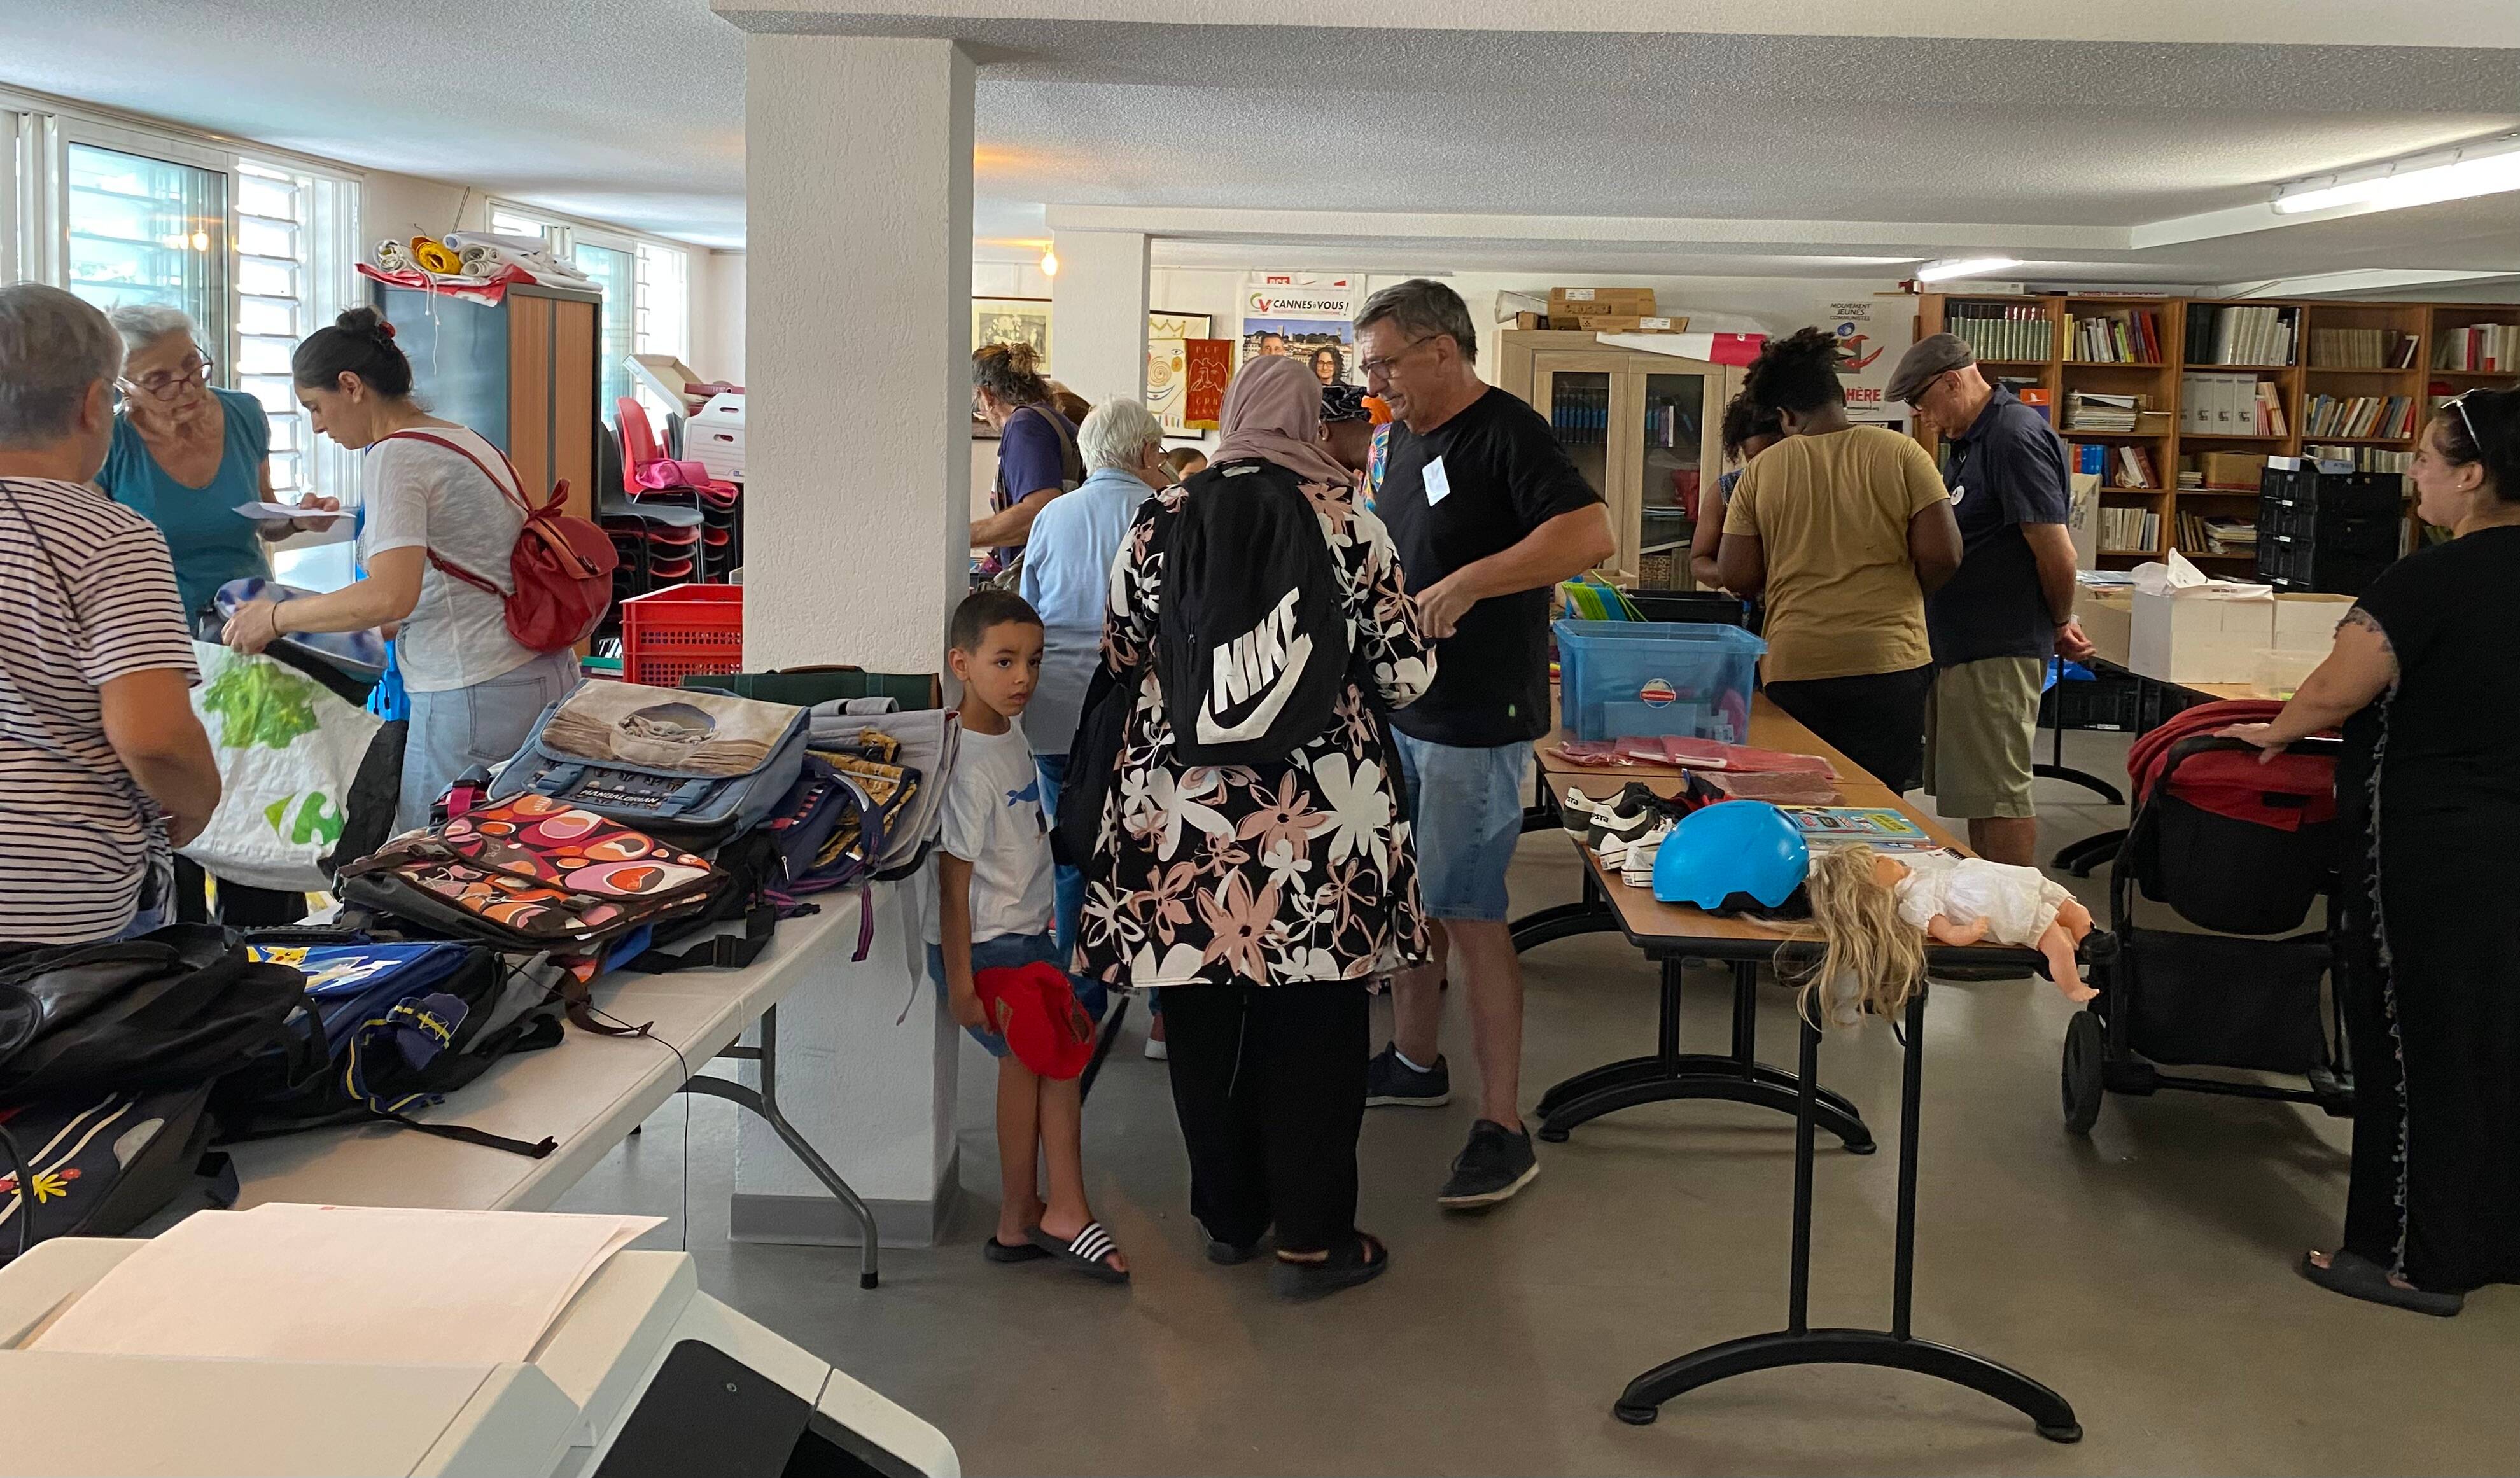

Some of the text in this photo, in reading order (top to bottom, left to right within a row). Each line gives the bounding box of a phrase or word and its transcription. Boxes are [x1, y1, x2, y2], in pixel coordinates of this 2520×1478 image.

[1273, 300, 1312, 309] CANNES
[1846, 386, 1881, 401] HÈRE
[1213, 587, 1305, 715] NIKE
[580, 790, 658, 803] MANDALORIAN
